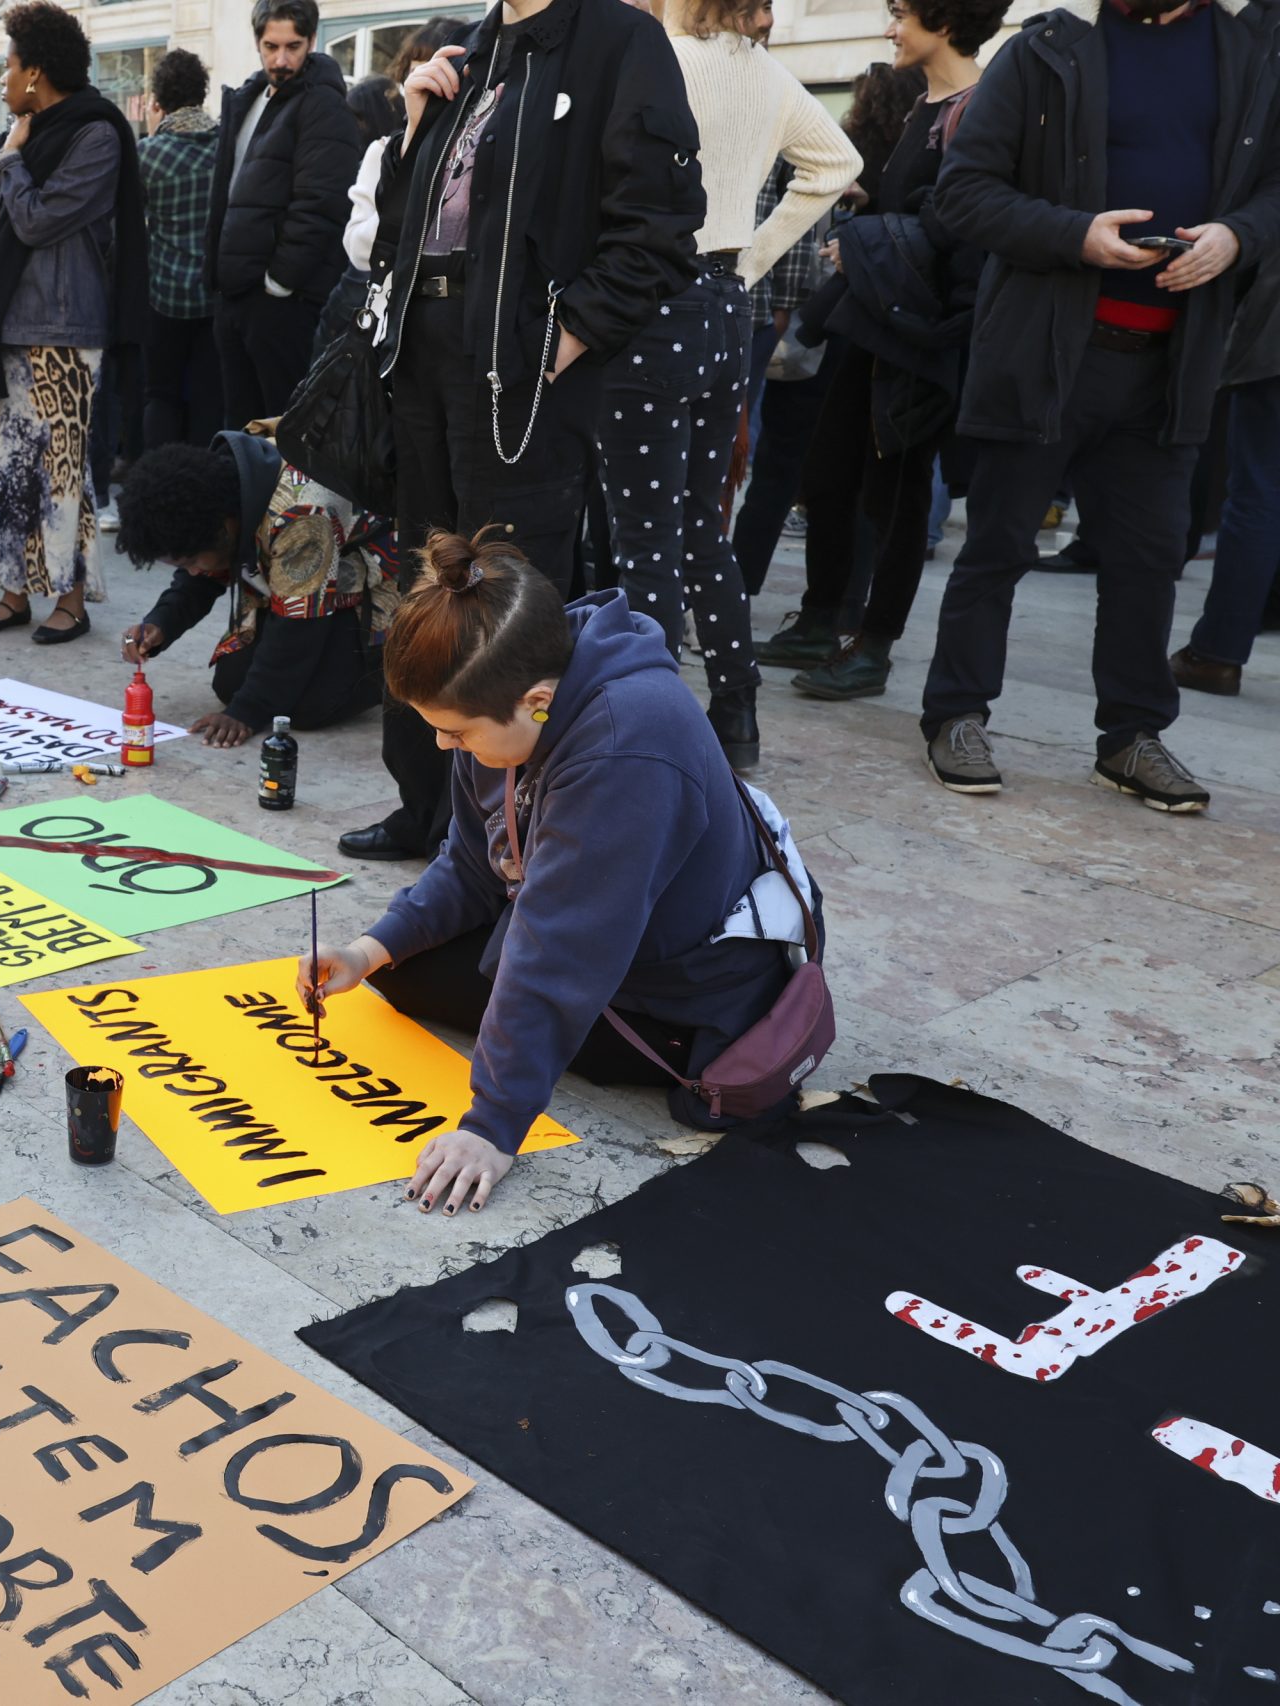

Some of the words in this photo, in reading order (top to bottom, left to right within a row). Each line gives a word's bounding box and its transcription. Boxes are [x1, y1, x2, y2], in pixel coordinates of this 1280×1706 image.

[22, 734, 104, 758] DAS
[68, 988, 326, 1188] IMMIGRANTS
[224, 991, 447, 1143] WELCOME
